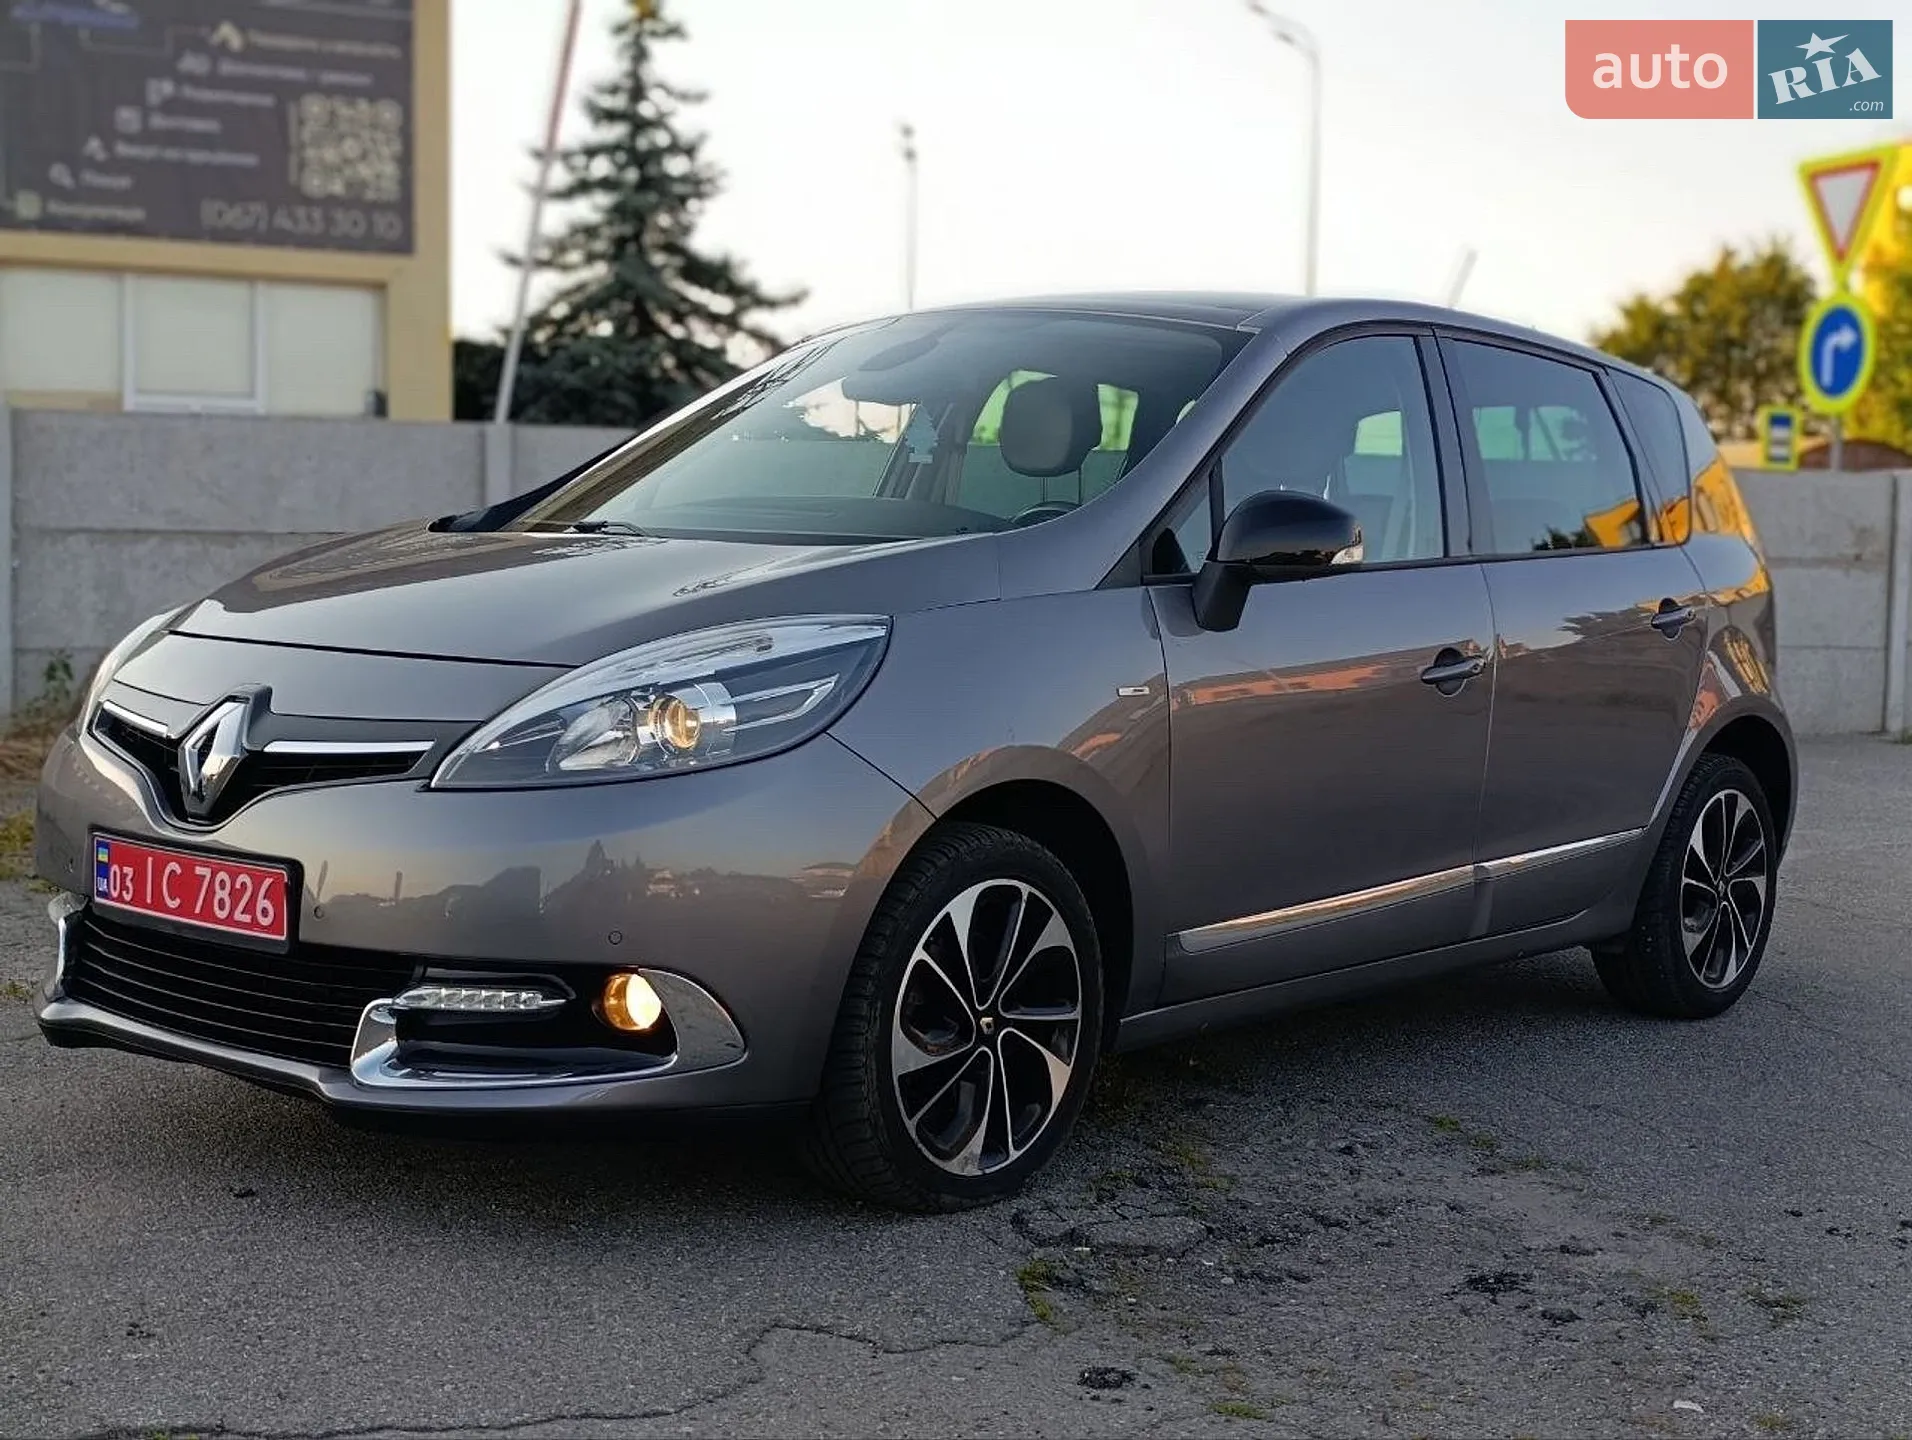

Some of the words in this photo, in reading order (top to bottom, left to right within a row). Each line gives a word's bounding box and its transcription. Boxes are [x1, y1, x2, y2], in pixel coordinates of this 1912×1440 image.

[201, 198, 268, 233] (067)
[272, 204, 325, 236] 433
[330, 207, 367, 238] 30
[372, 210, 402, 241] 10
[110, 864, 133, 901] 03
[195, 867, 274, 925] 7826
